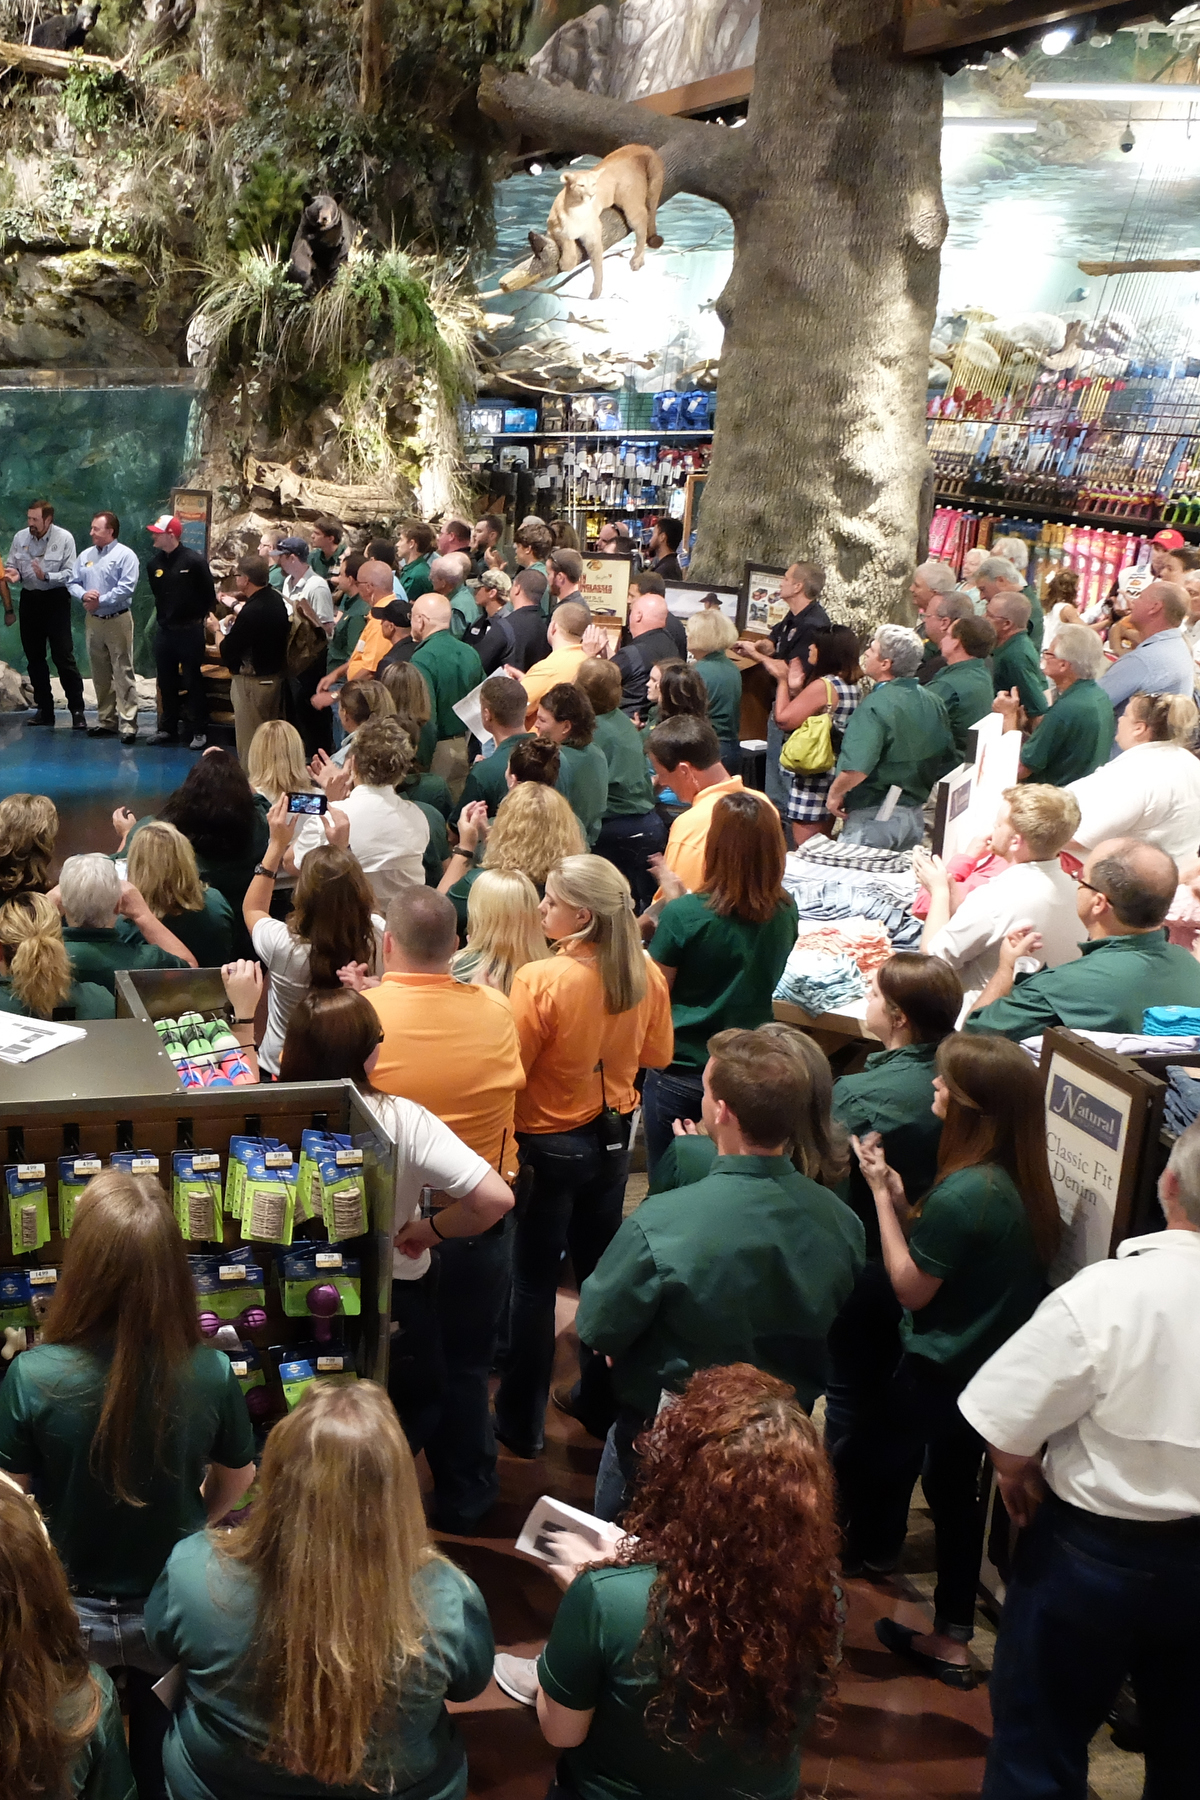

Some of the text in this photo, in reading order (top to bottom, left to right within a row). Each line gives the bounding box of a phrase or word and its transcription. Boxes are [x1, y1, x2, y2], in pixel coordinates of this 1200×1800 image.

[580, 584, 612, 594] NGLASSES
[1053, 1084, 1115, 1135] Natural
[1046, 1131, 1113, 1191] Classic Fit
[1052, 1159, 1098, 1206] Denim
